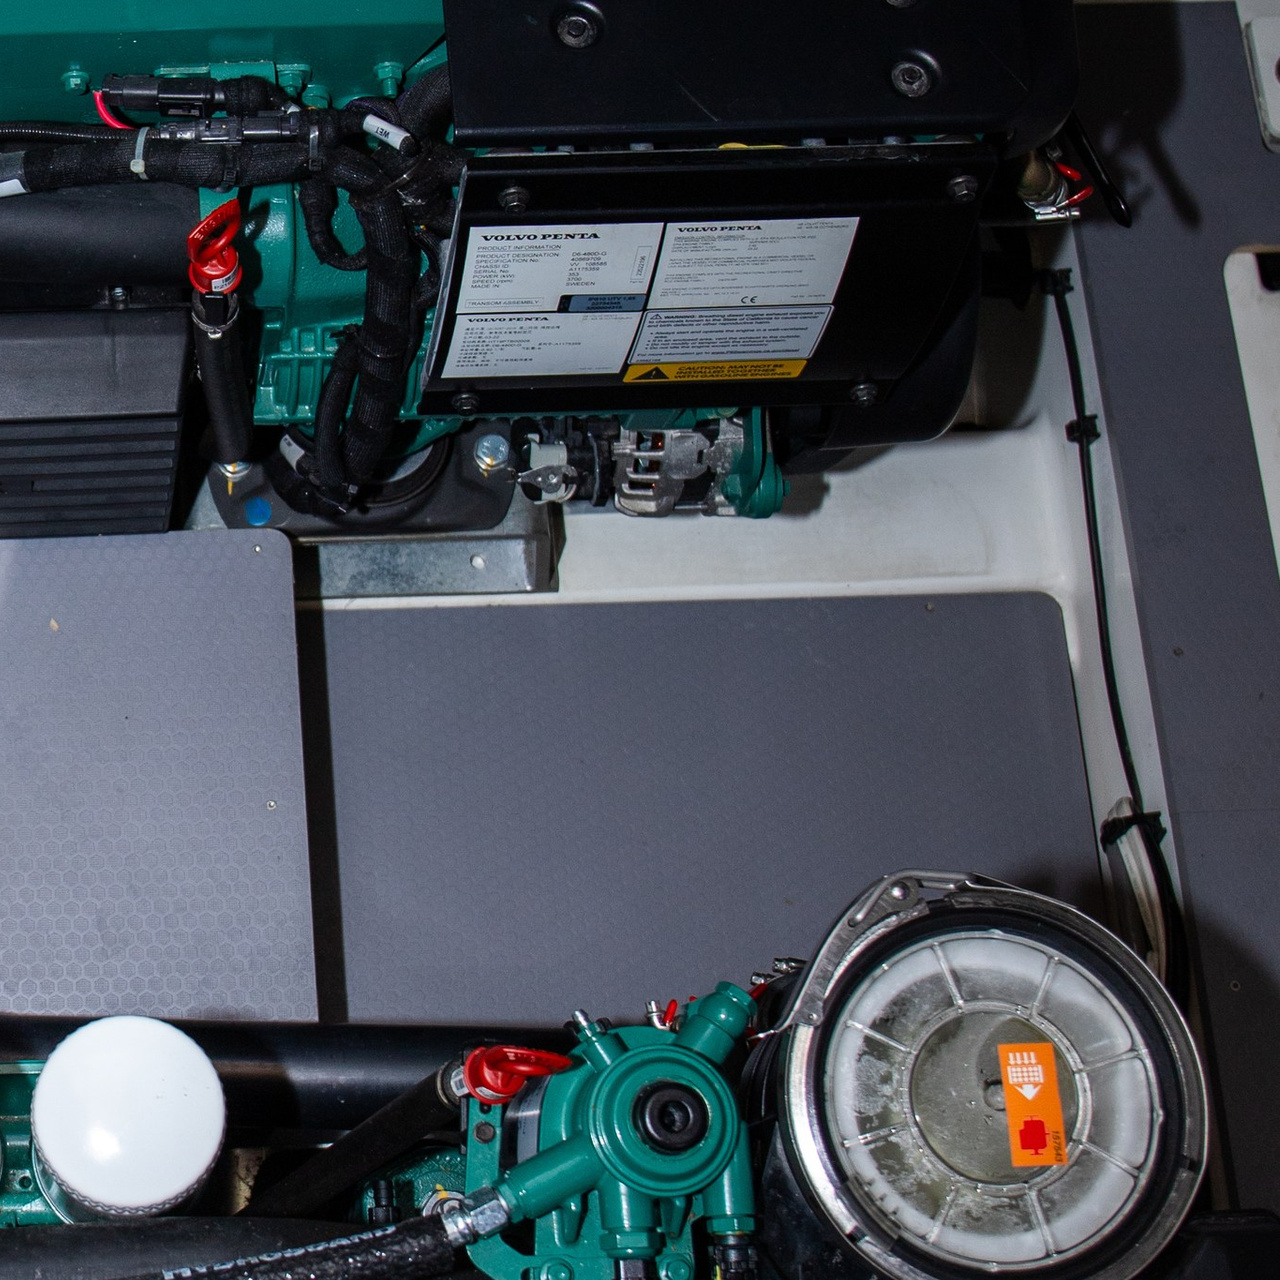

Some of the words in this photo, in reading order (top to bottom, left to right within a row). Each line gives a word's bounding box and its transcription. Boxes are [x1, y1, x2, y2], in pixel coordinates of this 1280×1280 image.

[375, 126, 390, 140] WET
[482, 233, 538, 241] VOLVO
[541, 232, 600, 240] PENTA
